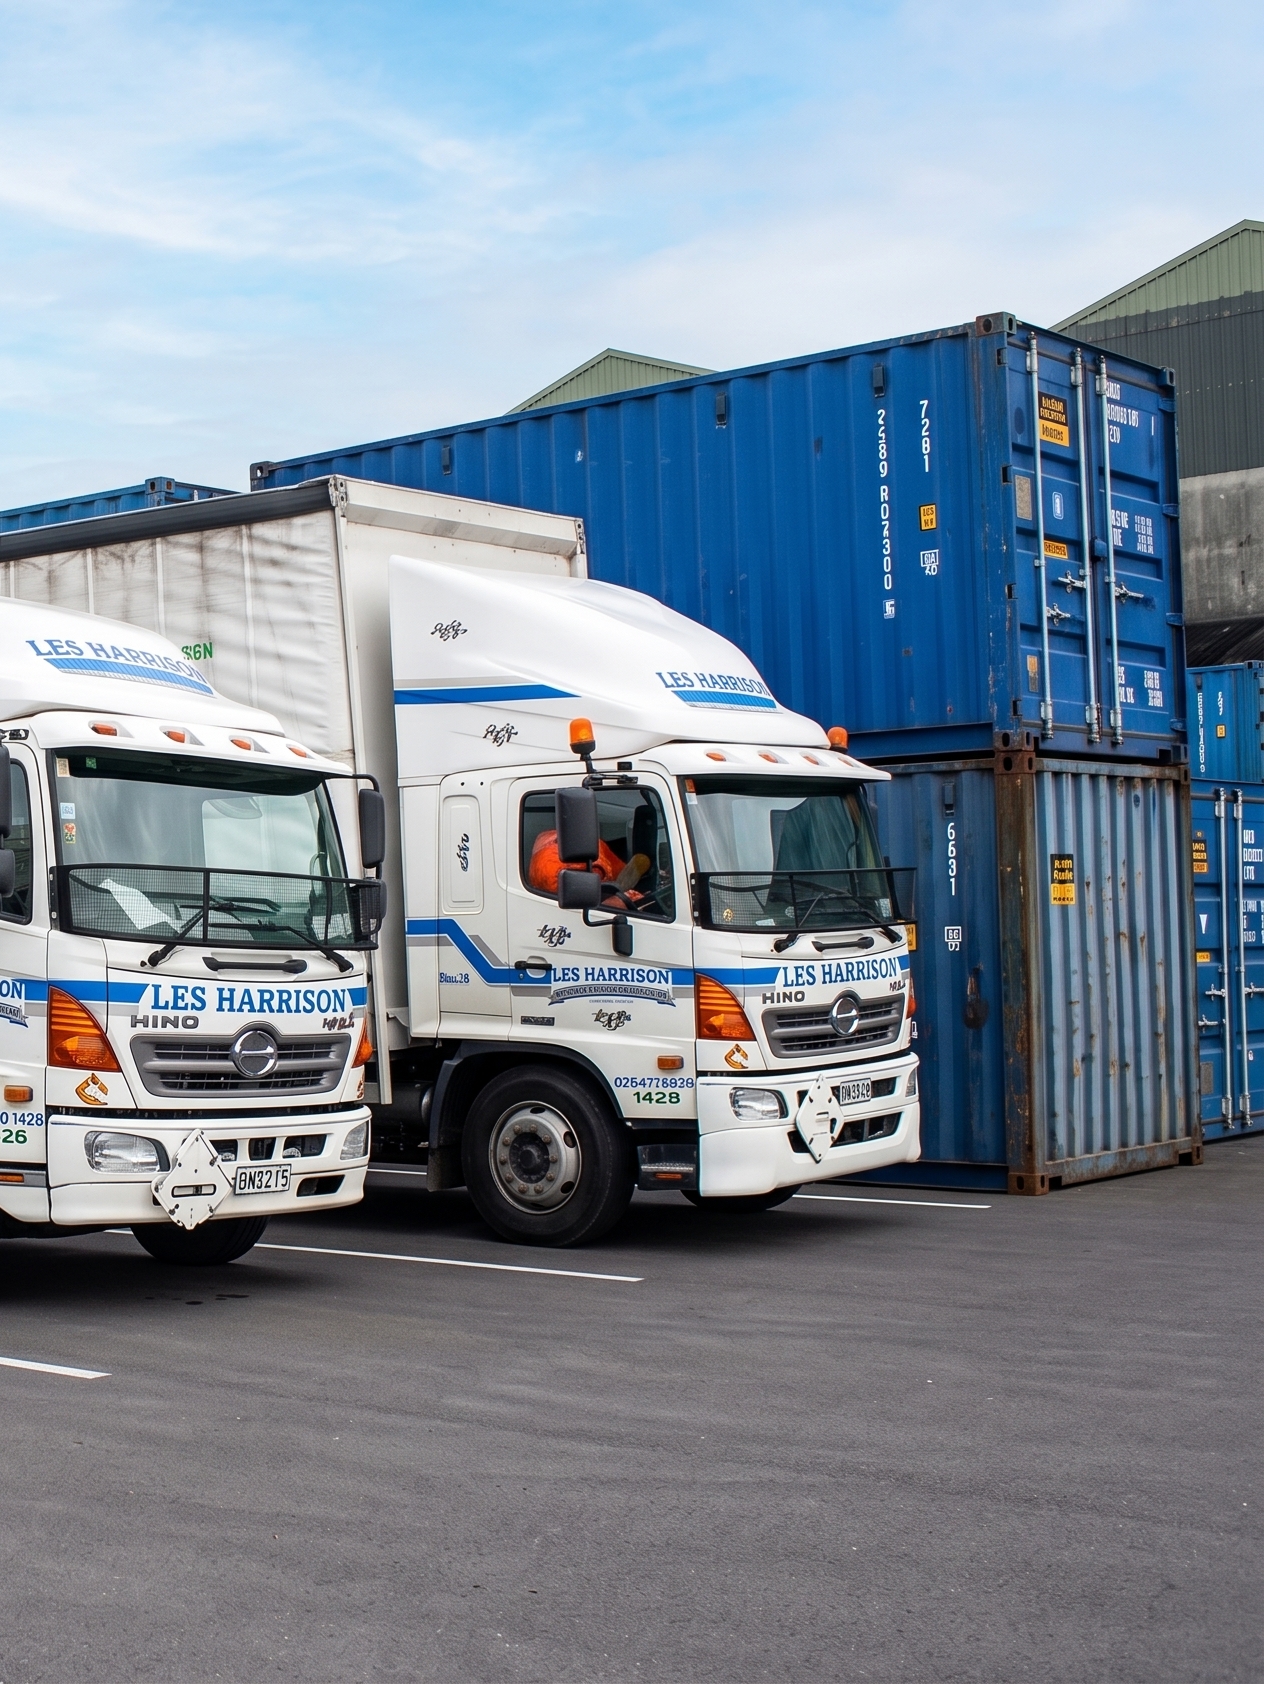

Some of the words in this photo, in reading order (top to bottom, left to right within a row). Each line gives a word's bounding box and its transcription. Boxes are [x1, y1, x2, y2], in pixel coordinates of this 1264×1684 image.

[919, 400, 930, 472] 7281
[26, 639, 84, 656] LES
[85, 641, 208, 685] HARRISON
[655, 672, 695, 688] LES
[693, 672, 771, 697] HARRISON
[947, 822, 956, 896] 6631
[552, 967, 580, 982] LES
[584, 967, 670, 984] HARRISON
[782, 965, 817, 987] LES
[821, 957, 898, 985] HARRISON
[151, 983, 206, 1012] LES
[216, 986, 347, 1014] HARRISON
[761, 990, 806, 1005] HINO
[130, 1014, 200, 1030] HINO
[633, 1091, 681, 1104] 1428
[12, 1112, 44, 1126] 1428
